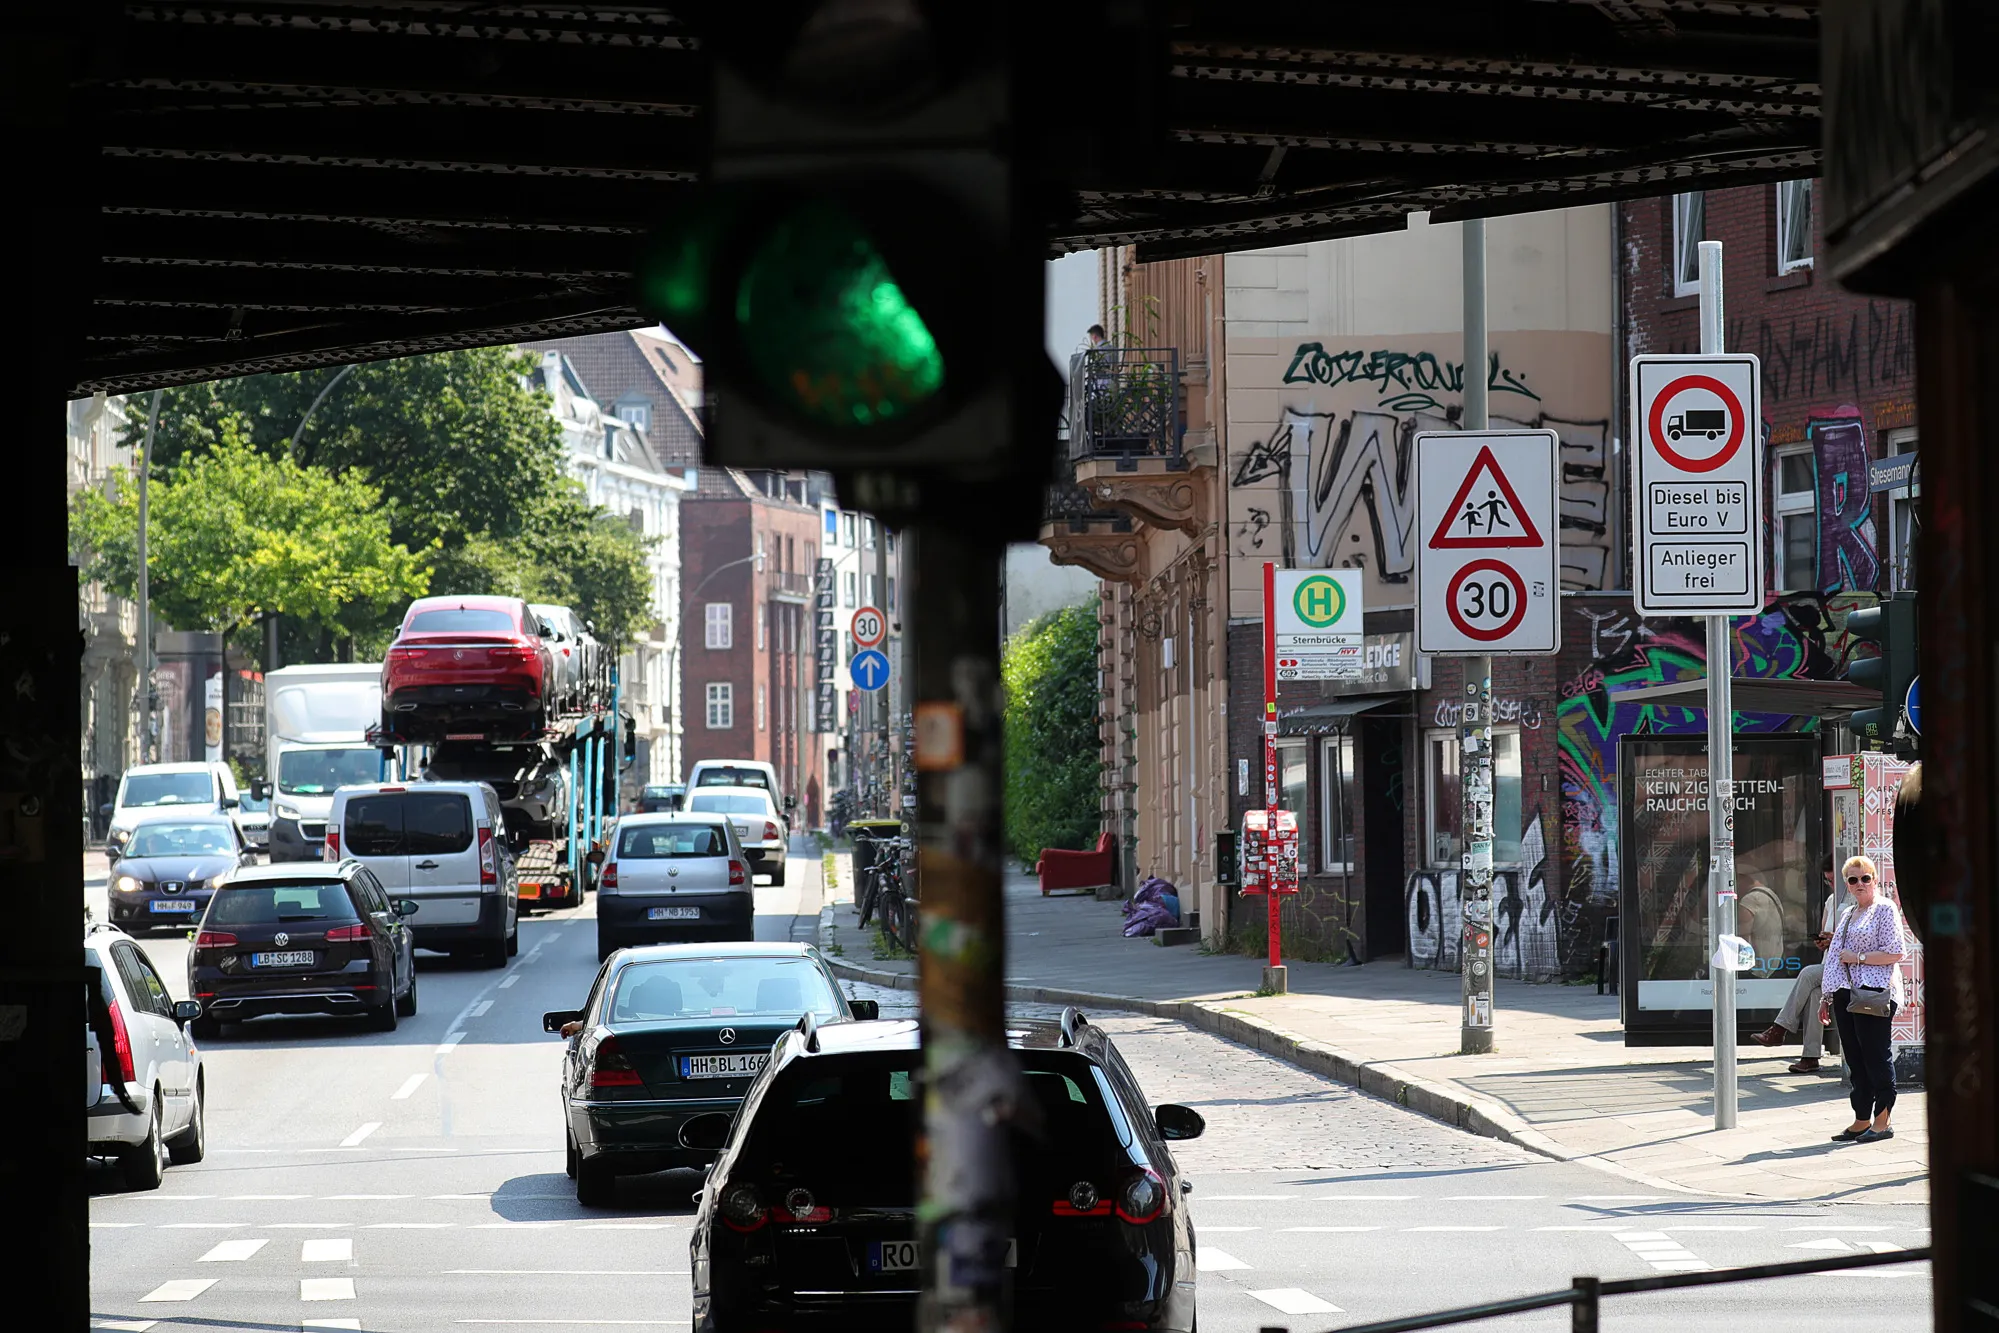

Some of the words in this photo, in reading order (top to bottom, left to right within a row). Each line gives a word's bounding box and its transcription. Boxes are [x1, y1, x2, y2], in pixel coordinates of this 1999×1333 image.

[1655, 488, 1709, 505] Diesel
[1716, 488, 1742, 505] bis
[1667, 512, 1708, 527] Euro
[1717, 512, 1729, 527] V
[1661, 550, 1737, 569] Anlieger
[1685, 572, 1715, 588] frei
[1307, 587, 1331, 616] H
[1463, 581, 1510, 619] 30
[857, 617, 878, 637] 30
[1292, 635, 1347, 644] Sternbrücke
[1287, 659, 1292, 667] 3
[1362, 643, 1400, 669] EDGE
[1281, 669, 1296, 677] 602
[1374, 671, 1389, 683] Club
[1645, 768, 1684, 778] ECHTER
[1645, 781, 1681, 795] KEIN
[1684, 780, 1785, 795] ZIGETTEN-
[654, 908, 664, 916] HH
[258, 954, 270, 964] LB
[276, 953, 288, 964] SC
[290, 952, 313, 963] 1288
[690, 1057, 709, 1074] HH
[718, 1056, 736, 1072] BL
[882, 1243, 920, 1268] RO
